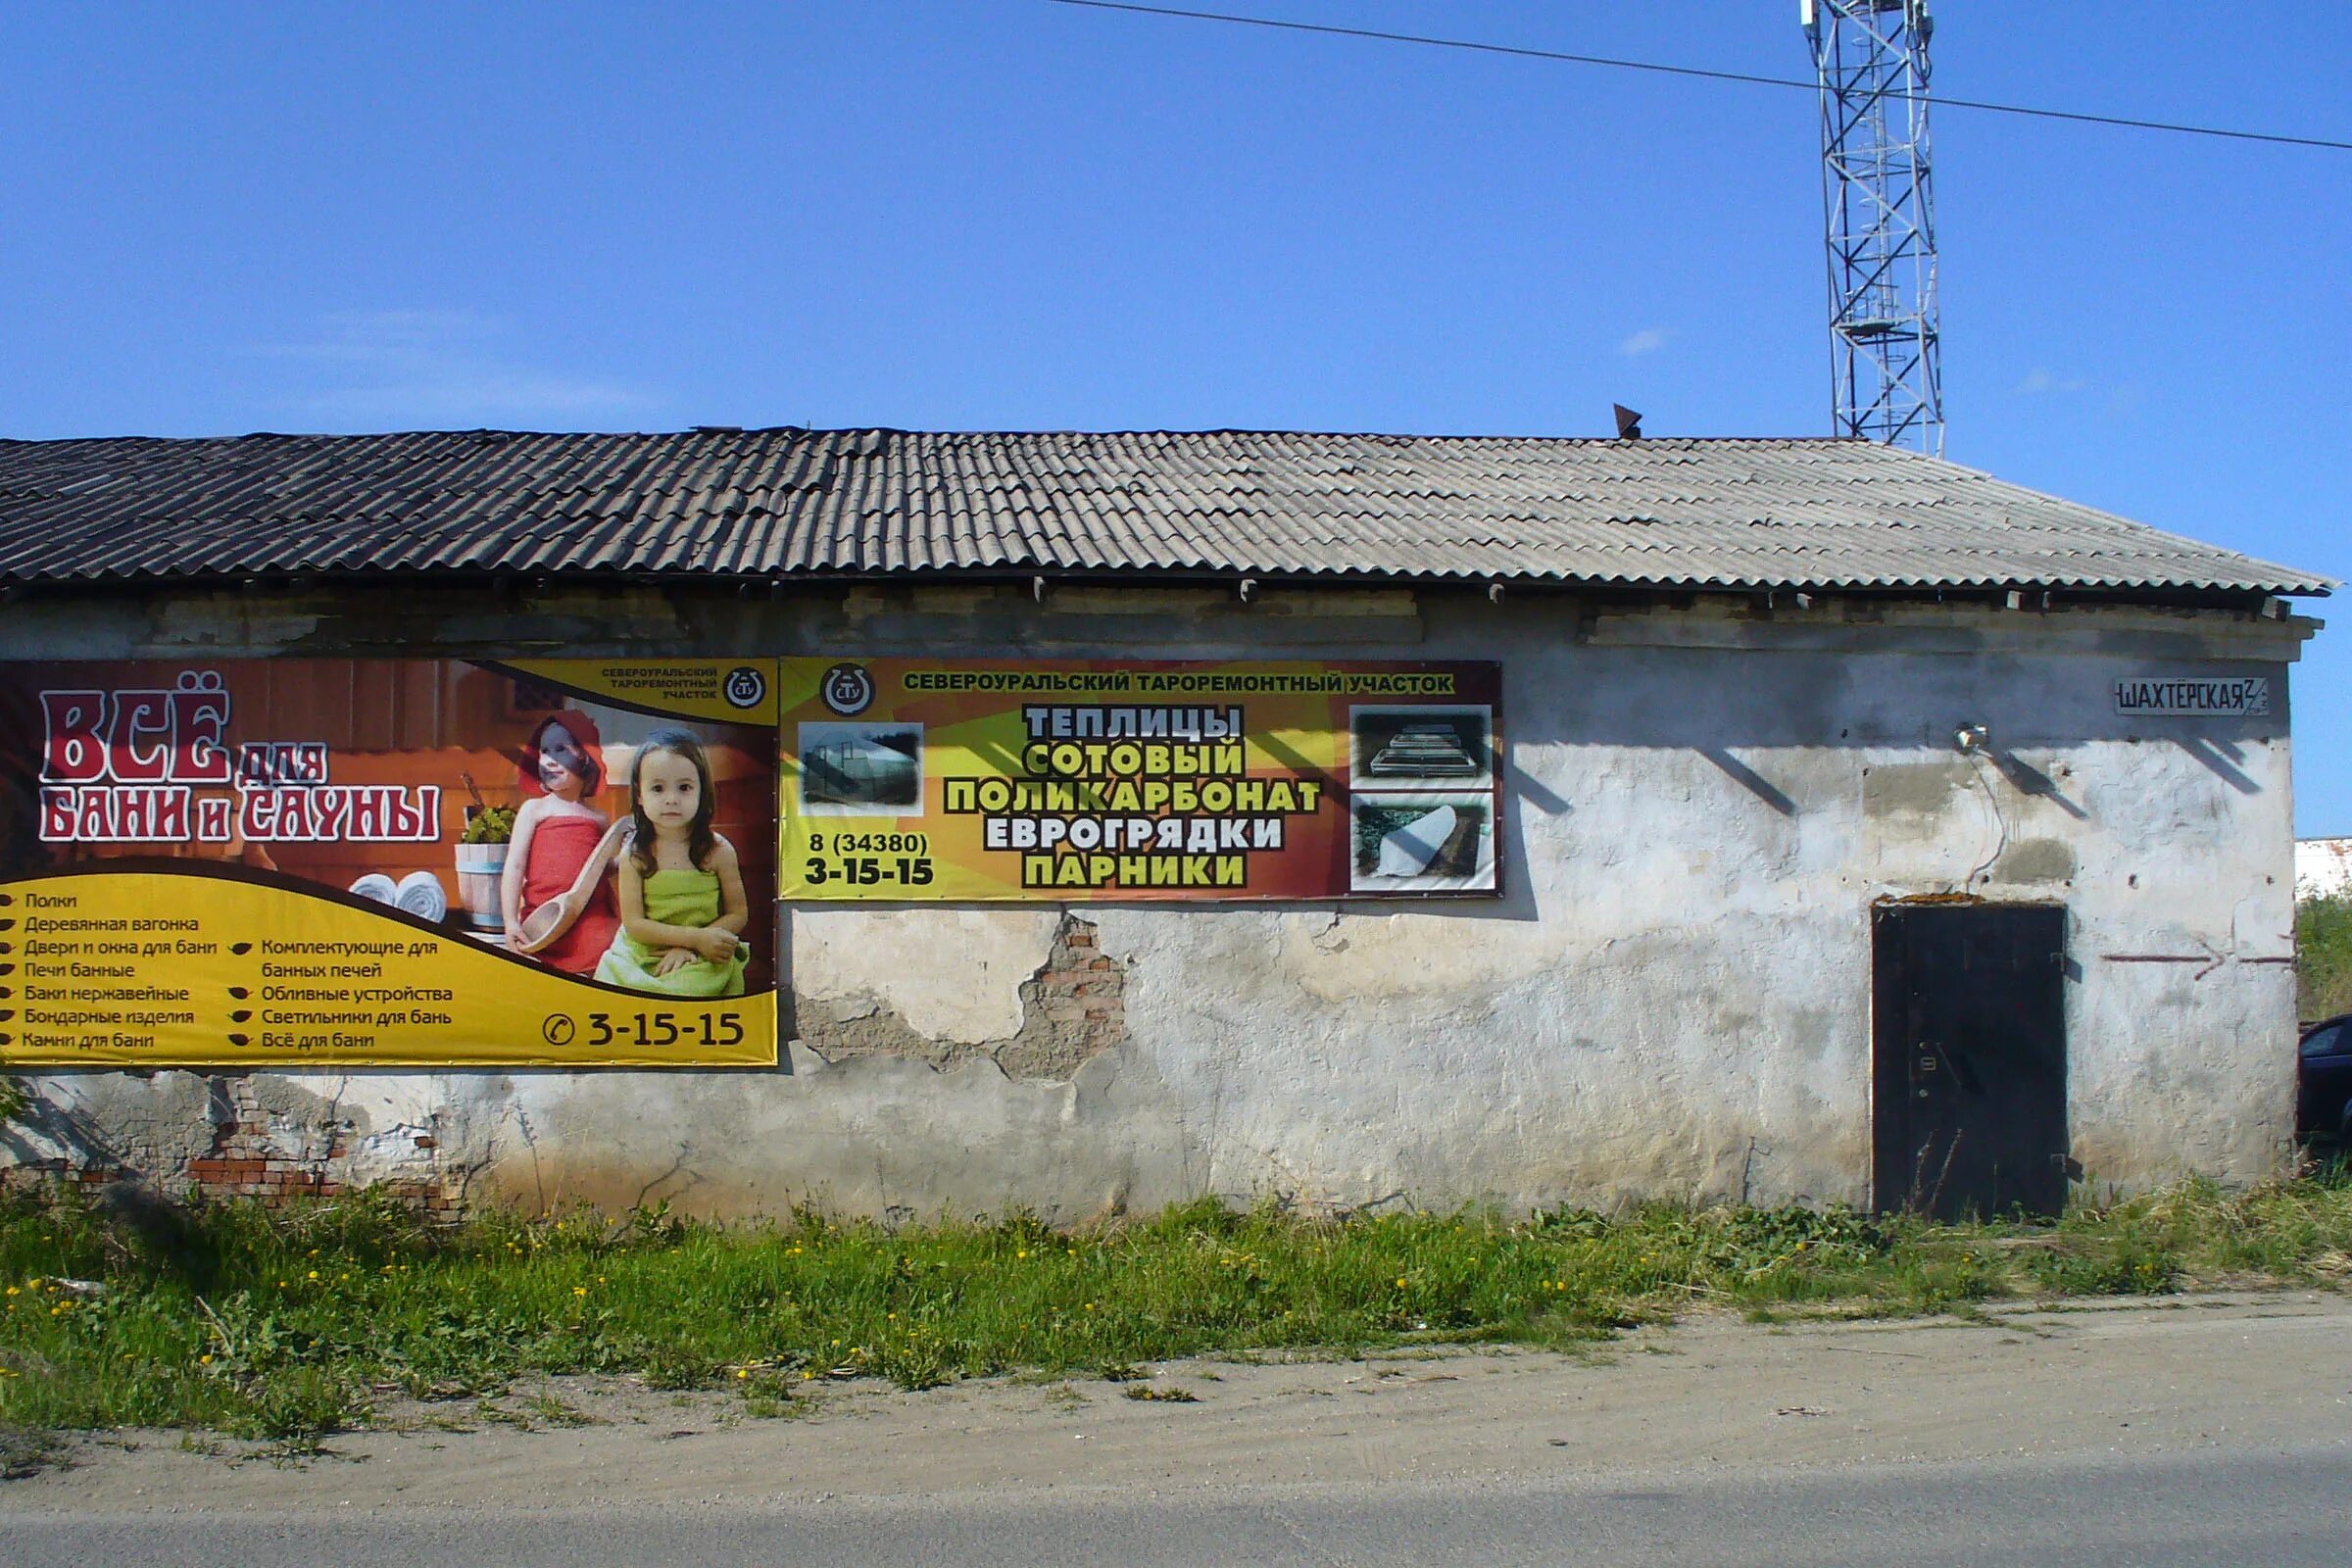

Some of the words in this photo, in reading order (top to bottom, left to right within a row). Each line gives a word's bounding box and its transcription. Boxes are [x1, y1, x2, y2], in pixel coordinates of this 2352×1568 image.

[904, 672, 1130, 692] СЕВЕРОУРАЛЬСКИЙ
[1137, 672, 1342, 692] ТАРОРЕМОНТНЫЙ
[1348, 675, 1452, 692] УЧАСТОК
[662, 690, 716, 699] УЧАСТОК
[1026, 707, 1241, 742] ТЕПЛИЦЫ
[1026, 737, 1243, 775] СОТОВЫЙ
[947, 781, 1320, 811] ПОЛИКАРБОНАТ
[39, 786, 191, 841] БАНИ
[239, 786, 440, 841] САУНЫ
[987, 817, 1282, 853] ЕВРОГРЯДКИ
[809, 834, 823, 852] 8
[833, 832, 927, 857] (34380)
[805, 858, 934, 886] 3-15-15
[1025, 855, 1244, 887] ПАРНИКИ
[25, 894, 76, 907] Полки
[24, 916, 127, 933] Деревянная
[132, 919, 198, 931] вагонка
[24, 940, 78, 956] Двери
[83, 942, 93, 954] и
[98, 943, 138, 954] окна
[143, 942, 171, 956] для
[176, 940, 217, 954] бани
[262, 940, 404, 956] Комплектующие
[409, 943, 438, 956] для
[24, 963, 66, 977] Печи
[71, 963, 134, 977] банные
[262, 963, 326, 978] банных
[331, 963, 381, 977] печей
[24, 986, 66, 1001] Баки
[72, 985, 189, 1004] нержавейные
[262, 986, 349, 1001] Обливные
[354, 986, 453, 1004] устройства
[24, 1009, 122, 1026] Бондарные
[126, 1012, 194, 1026] изделия
[262, 1009, 372, 1023] Светильники
[376, 1012, 406, 1027] для
[411, 1009, 452, 1023] бань
[589, 1013, 744, 1046] 3-15-15
[23, 1032, 74, 1047] Камни
[79, 1035, 108, 1050] для
[113, 1032, 154, 1047] бани
[262, 1033, 294, 1047] Всё
[298, 1036, 327, 1050] для
[332, 1033, 373, 1047] бани
